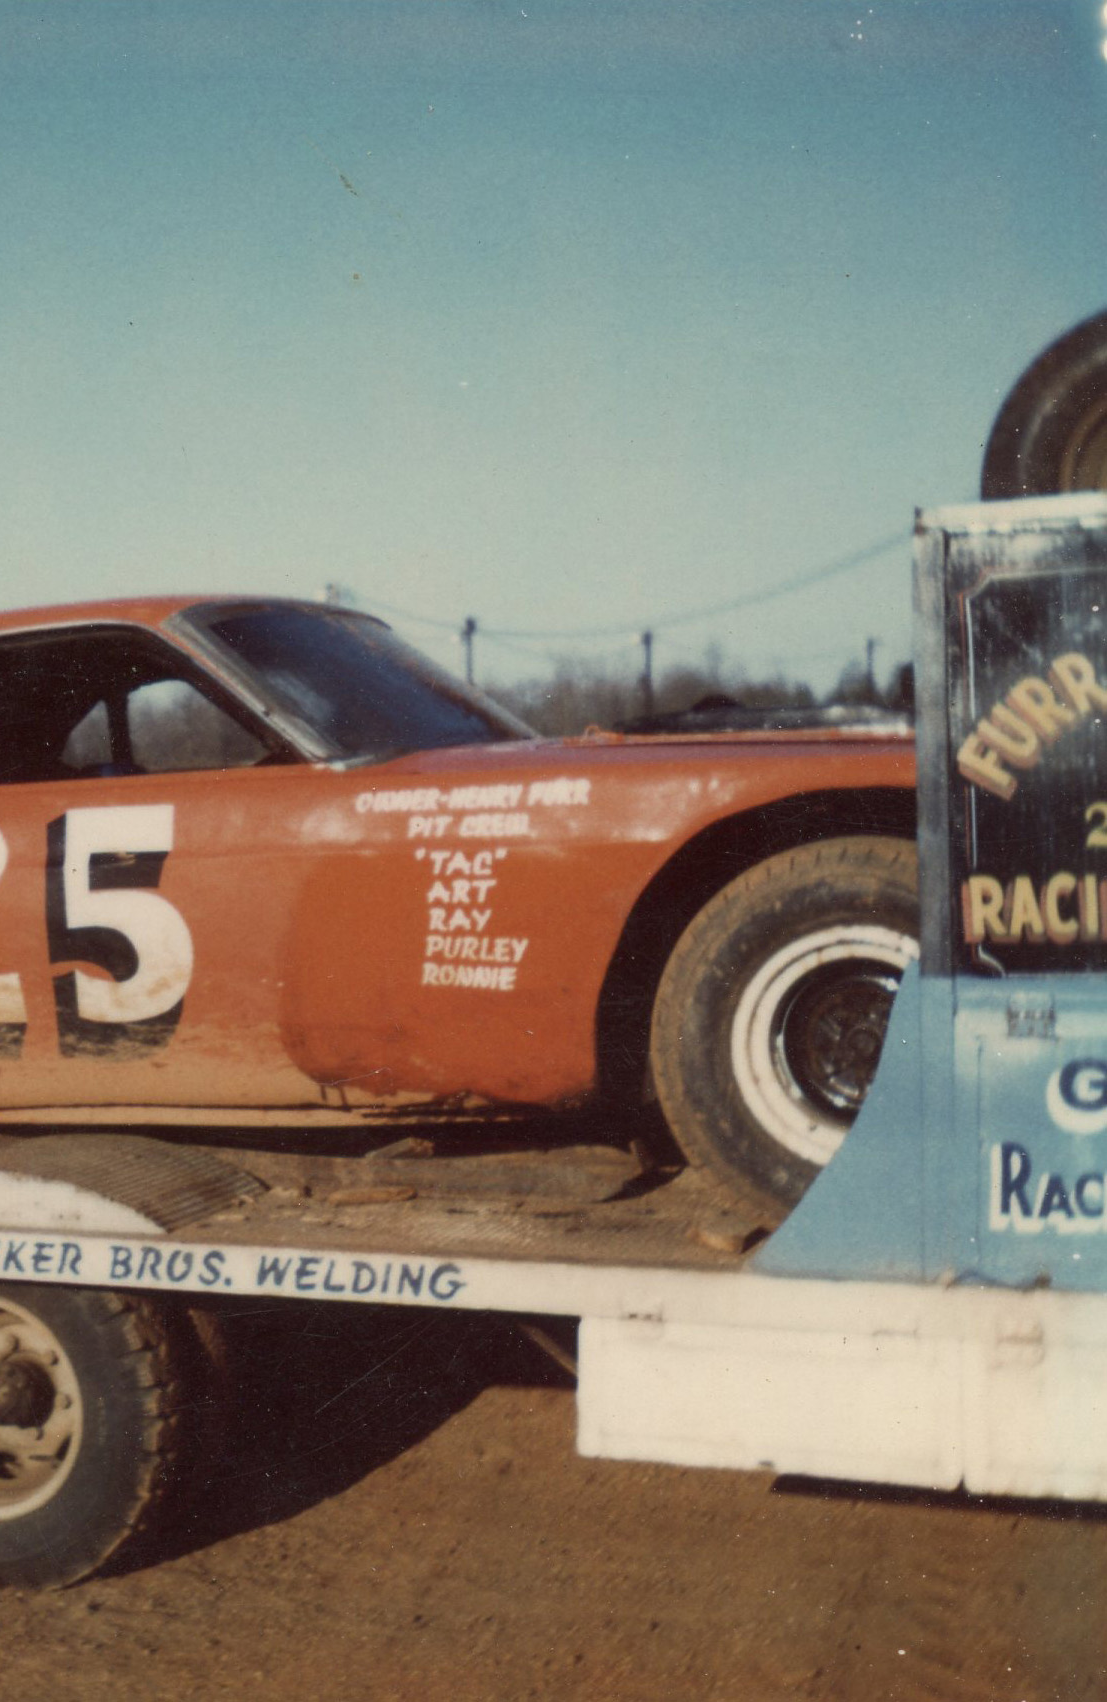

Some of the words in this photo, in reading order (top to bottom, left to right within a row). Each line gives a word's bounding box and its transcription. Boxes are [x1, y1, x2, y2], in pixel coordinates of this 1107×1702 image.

[407, 816, 454, 839] PIT
[426, 879, 497, 904] ART
[428, 907, 492, 932] RAY
[961, 871, 1107, 945] RACI
[424, 935, 529, 963] PURLEY
[421, 961, 517, 992] RONNIE
[989, 1140, 1107, 1233] RAC
[109, 1245, 232, 1287] BROS.
[255, 1254, 468, 1300] WELDING
